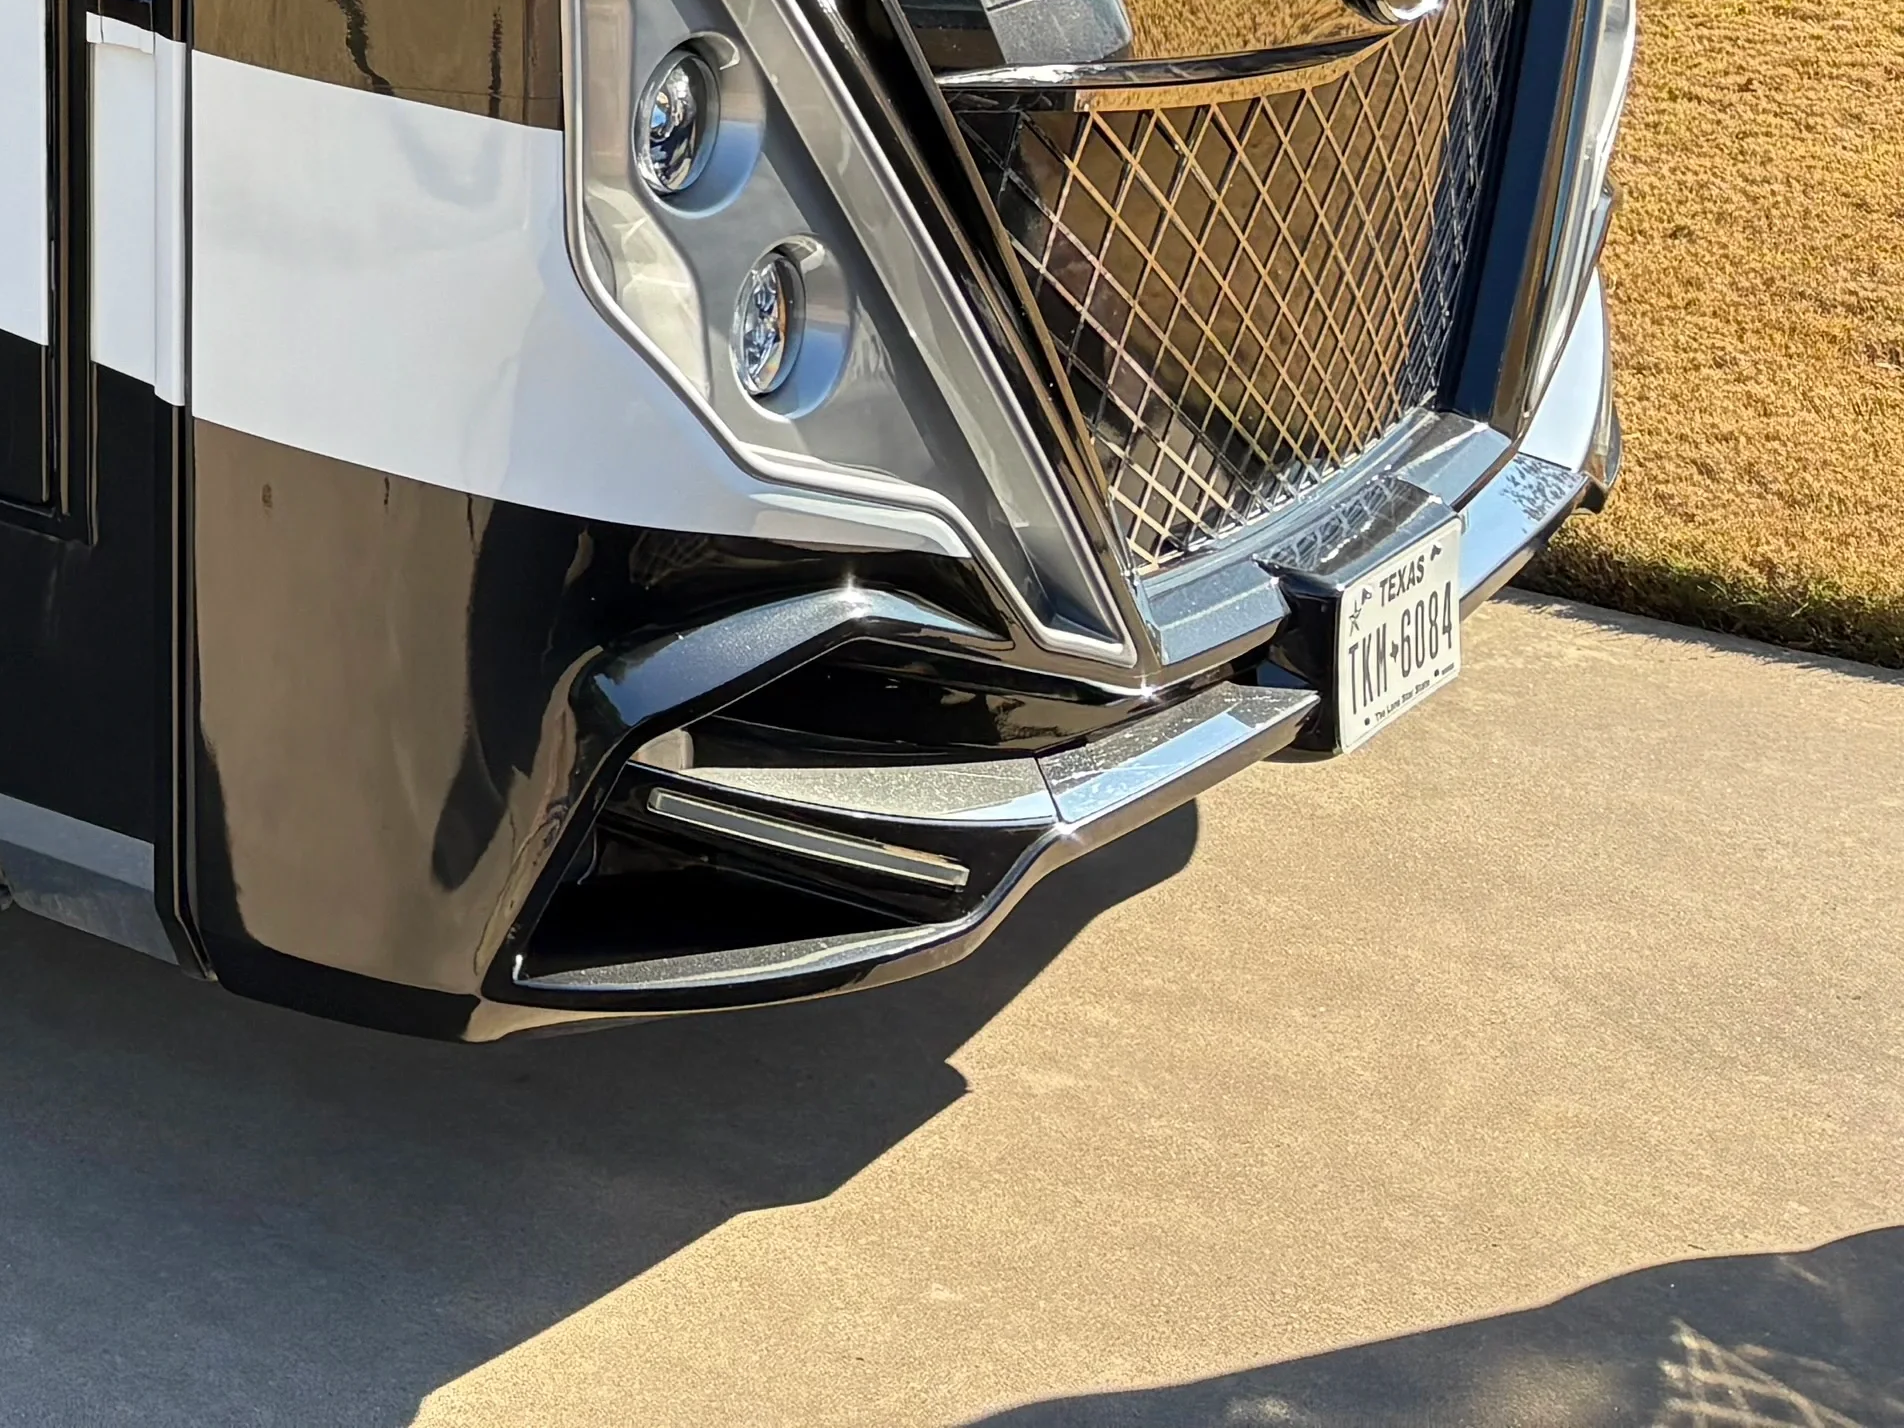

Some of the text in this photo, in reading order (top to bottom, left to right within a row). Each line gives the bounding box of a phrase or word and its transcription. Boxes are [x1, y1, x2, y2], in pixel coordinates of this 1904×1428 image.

[1379, 554, 1425, 608] TEXAS
[1348, 580, 1453, 715] TKM 6084
